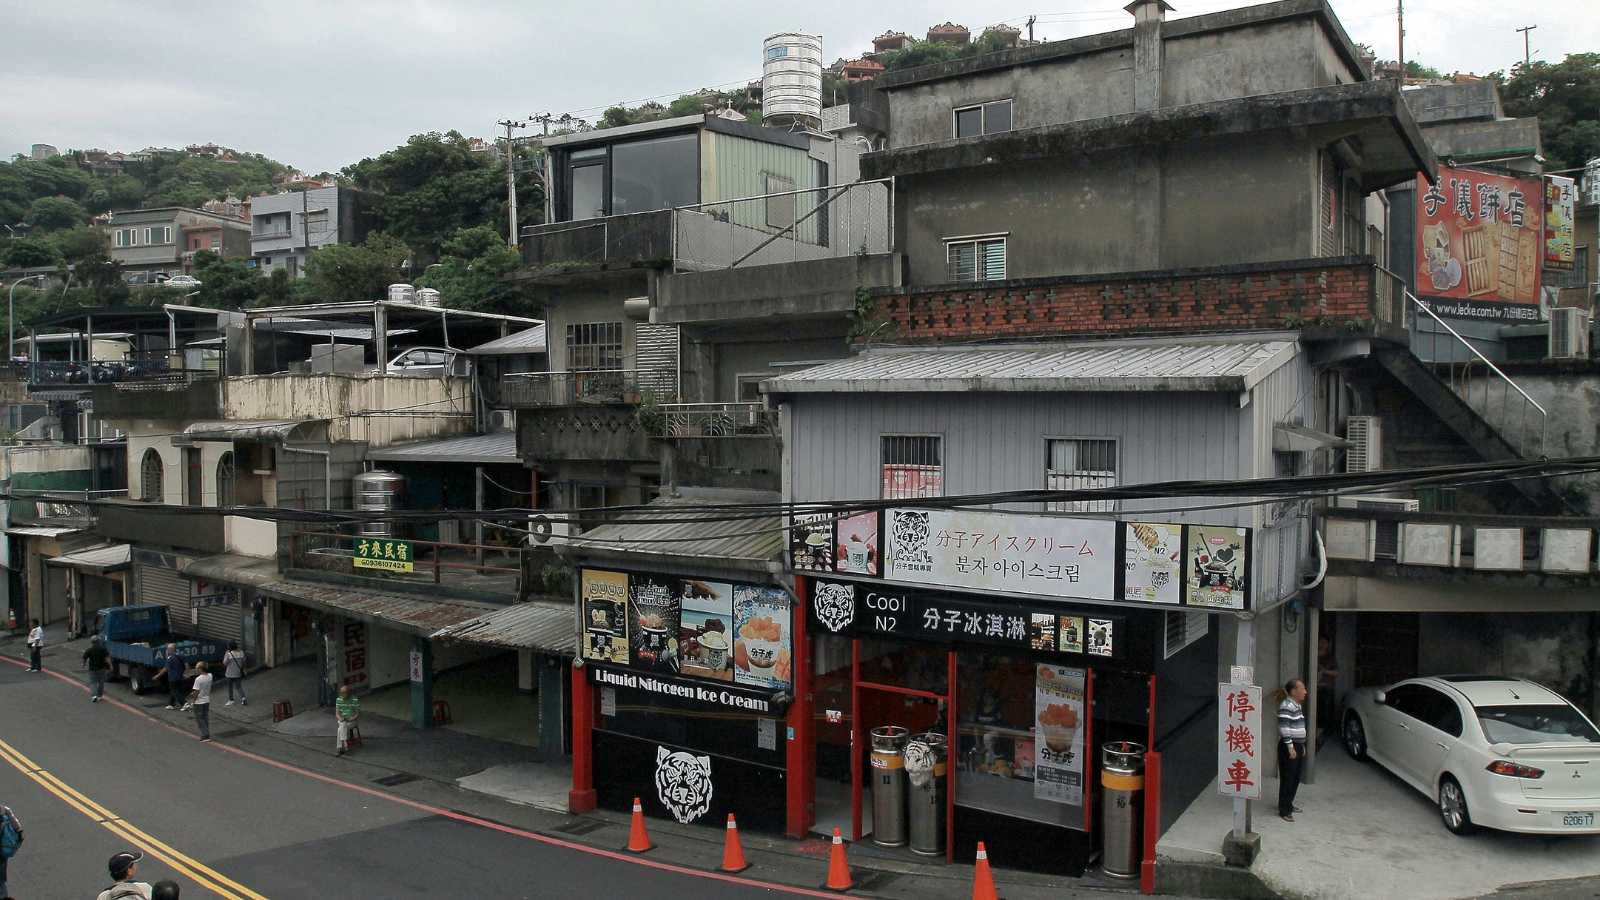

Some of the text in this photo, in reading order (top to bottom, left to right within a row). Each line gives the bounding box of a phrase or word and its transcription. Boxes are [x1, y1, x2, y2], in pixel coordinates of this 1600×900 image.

[358, 539, 408, 561] 方來民宿
[936, 530, 1094, 557] 分子アイスクリーム
[866, 592, 907, 612] Cool
[875, 616, 897, 633] N2
[922, 607, 1027, 641] 分子冰淇淋
[343, 622, 365, 673] 民宿
[595, 668, 769, 713] Liquid Nitrogen Ice Cream
[1224, 690, 1256, 793] 停機車
